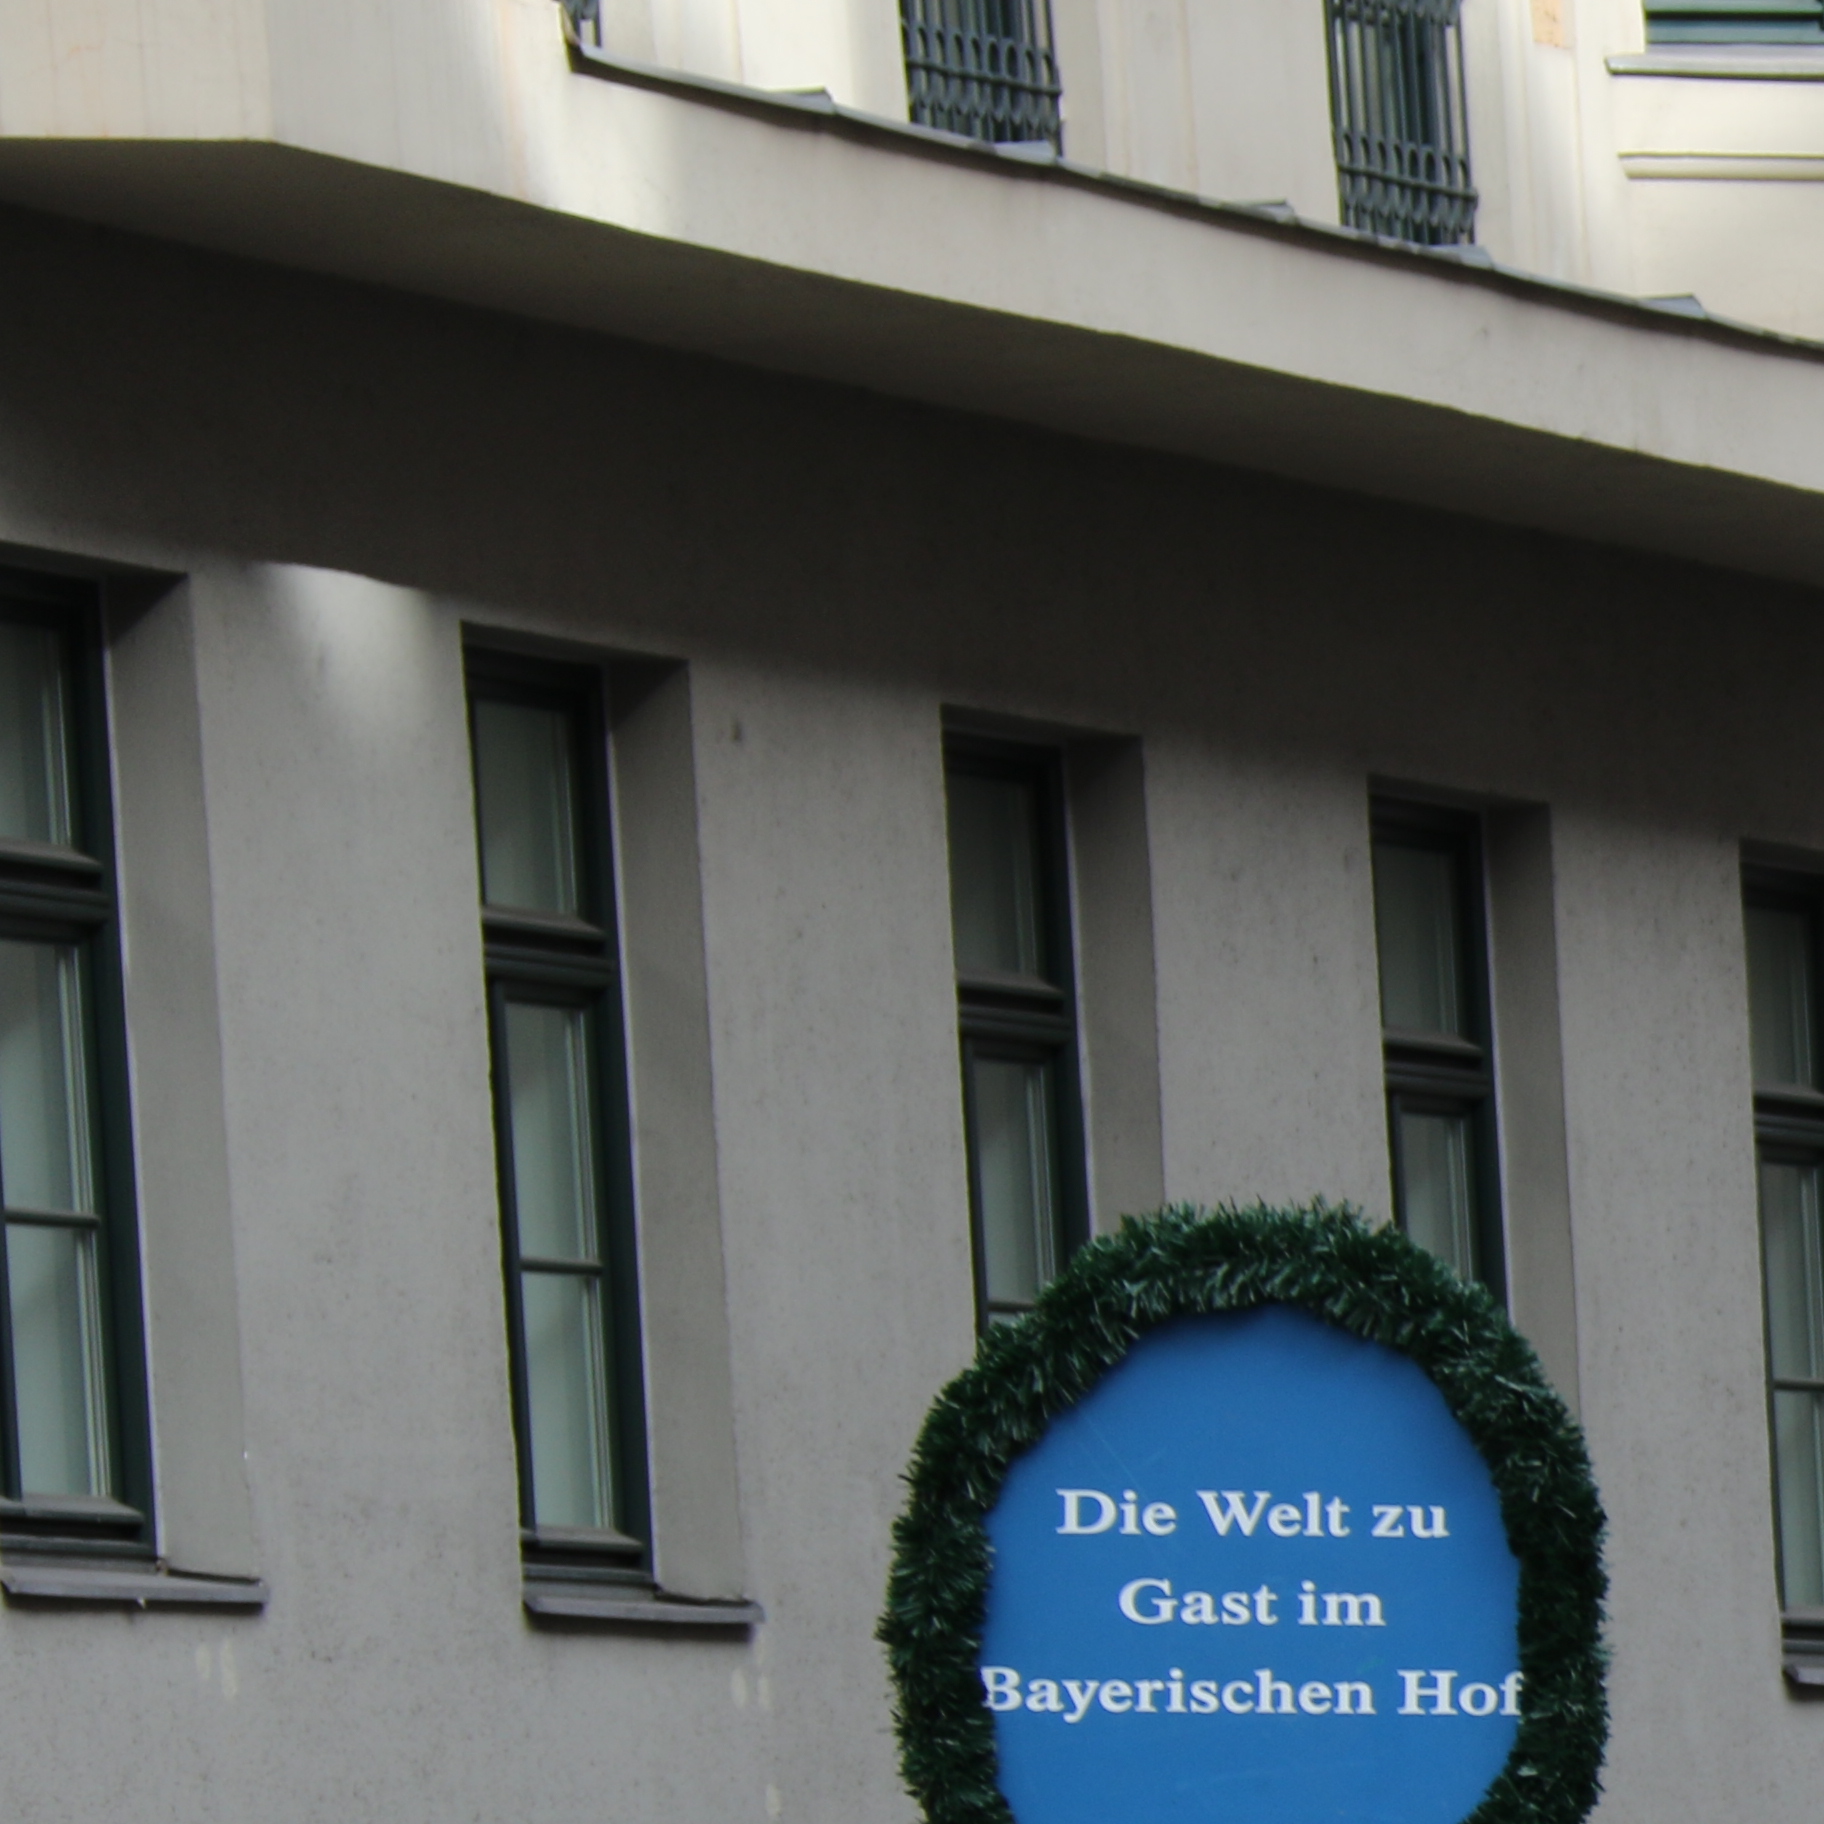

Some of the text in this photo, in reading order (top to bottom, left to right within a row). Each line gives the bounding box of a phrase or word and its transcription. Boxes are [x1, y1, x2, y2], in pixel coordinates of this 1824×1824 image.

[1056, 1489, 1449, 1538] Die Welt zu
[1118, 1577, 1386, 1626] Gast im
[979, 1665, 1524, 1724] Bayerischen Hof
